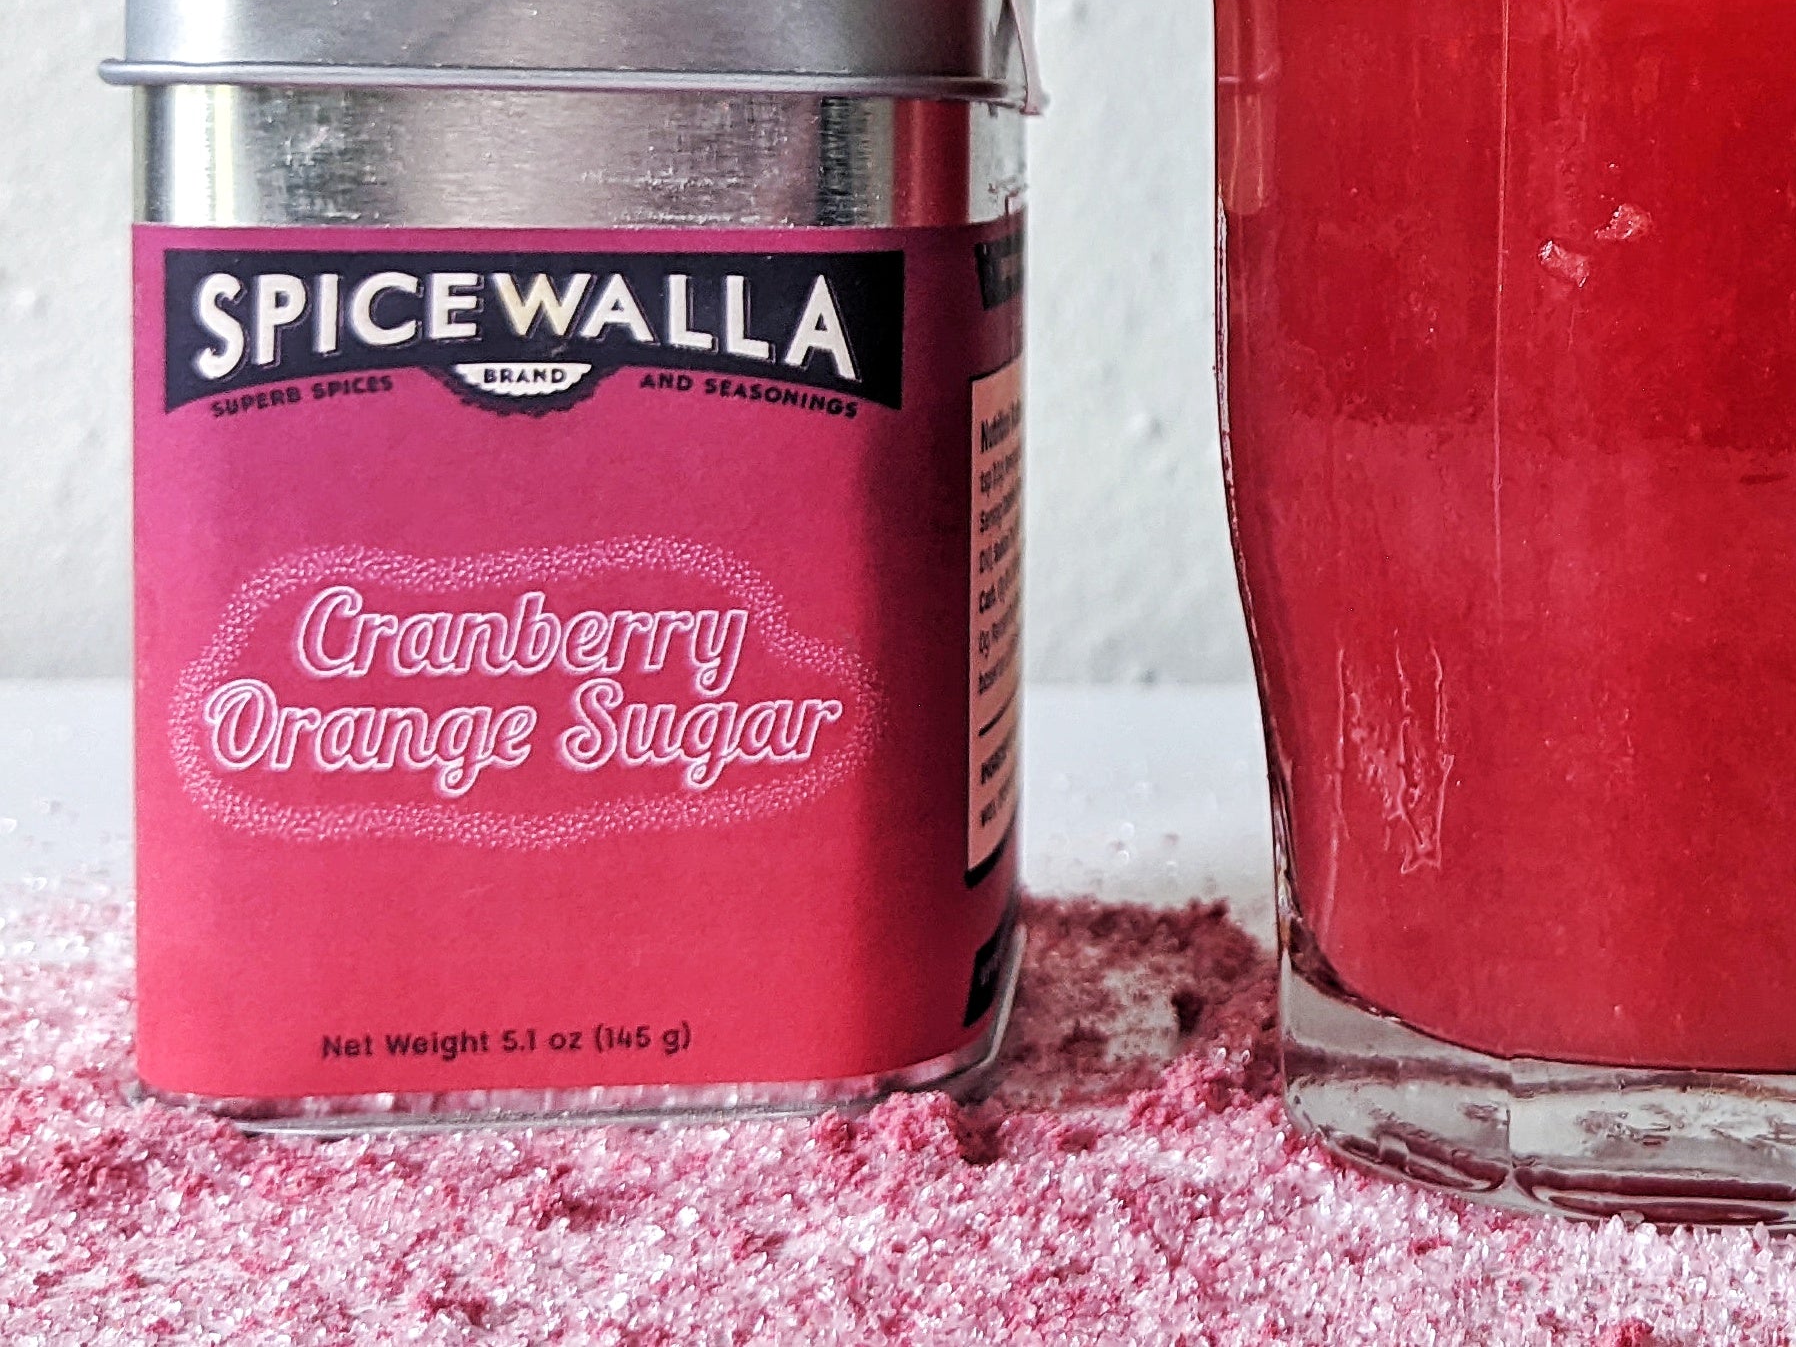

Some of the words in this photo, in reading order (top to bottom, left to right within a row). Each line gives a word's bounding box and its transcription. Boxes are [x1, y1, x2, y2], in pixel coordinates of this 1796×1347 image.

[193, 270, 862, 382] SPICEWALLA
[209, 386, 304, 417] SUPERB
[309, 374, 395, 401] SPICES
[483, 366, 567, 386] BRAND
[639, 372, 695, 393] AND
[703, 379, 860, 419] SEASONINGS
[298, 585, 748, 696] Cranberry
[203, 677, 538, 797] Orange
[557, 677, 843, 788] Sugar
[322, 1034, 374, 1058] Net
[384, 1029, 491, 1062] Weight
[502, 1028, 537, 1053] 5.1
[548, 1031, 583, 1051] oz
[595, 1022, 652, 1052] (145
[662, 1021, 692, 1055] g)
